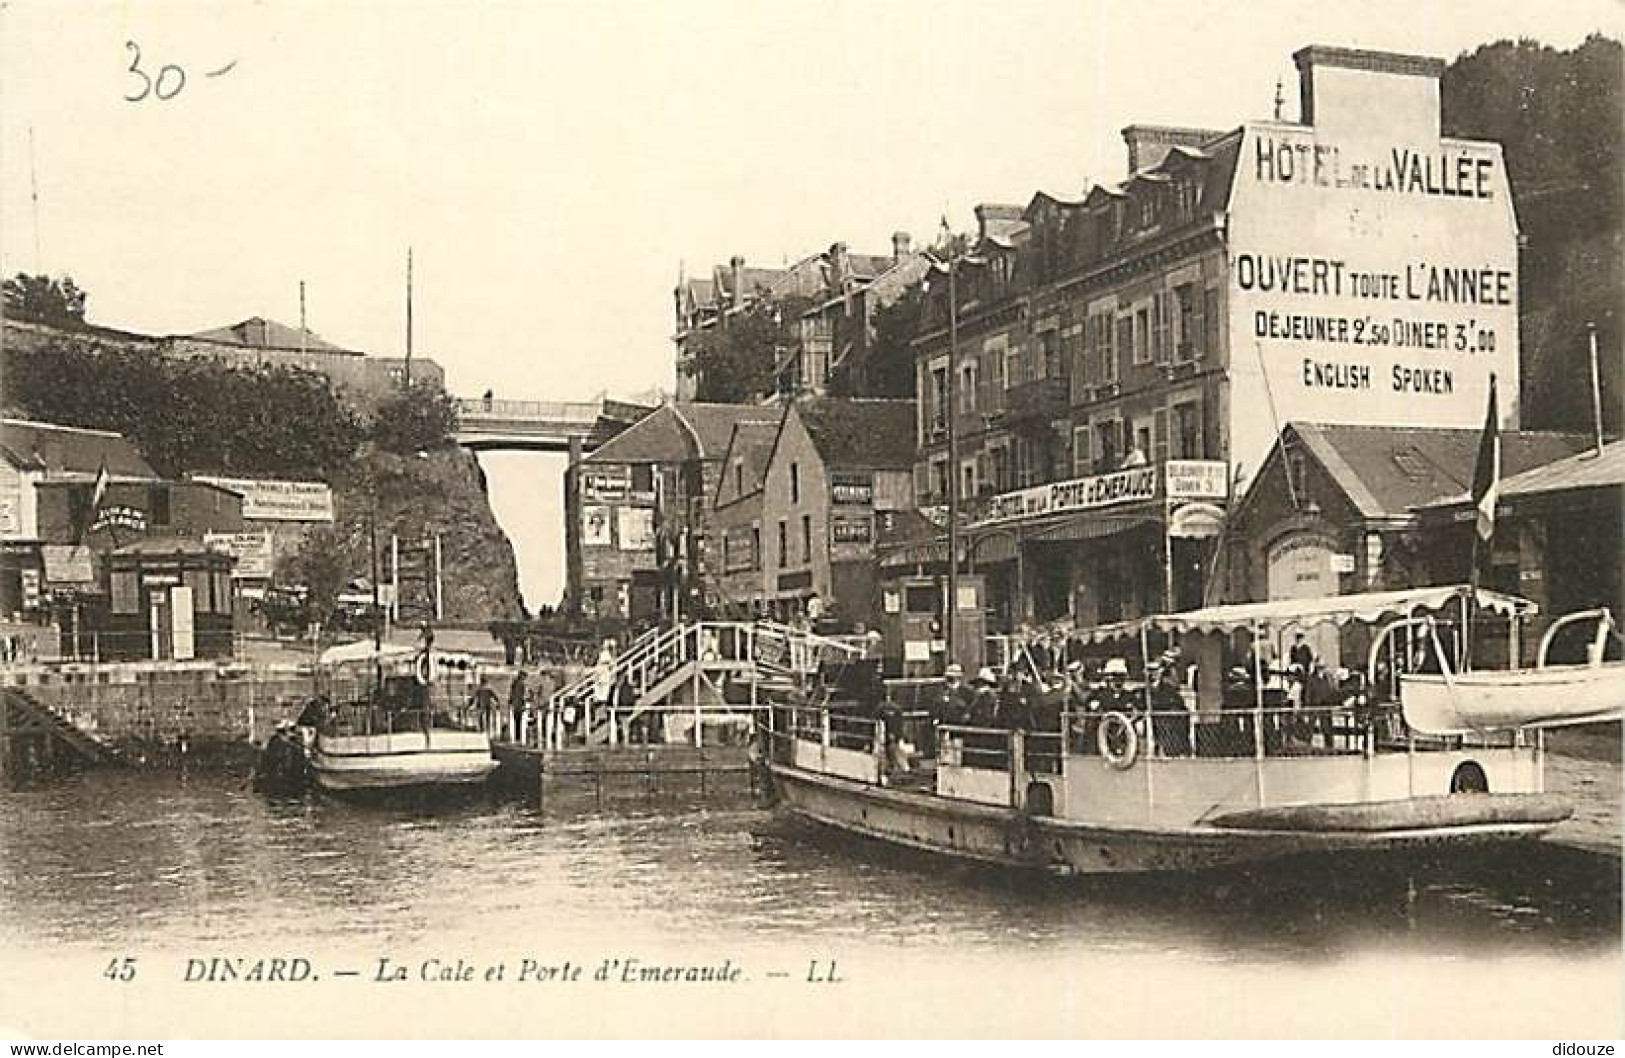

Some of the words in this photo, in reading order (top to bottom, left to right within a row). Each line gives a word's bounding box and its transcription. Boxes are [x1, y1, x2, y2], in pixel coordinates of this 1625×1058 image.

[1392, 147, 1493, 199] VALLÉE
[1238, 255, 1344, 296] OUVERT
[1350, 272, 1399, 299] TOUTE
[1406, 263, 1511, 305] L'ANNÉE
[1304, 358, 1370, 388] ENGLISH
[1393, 364, 1453, 393] SPOKEN
[1051, 481, 1084, 511] PORTE
